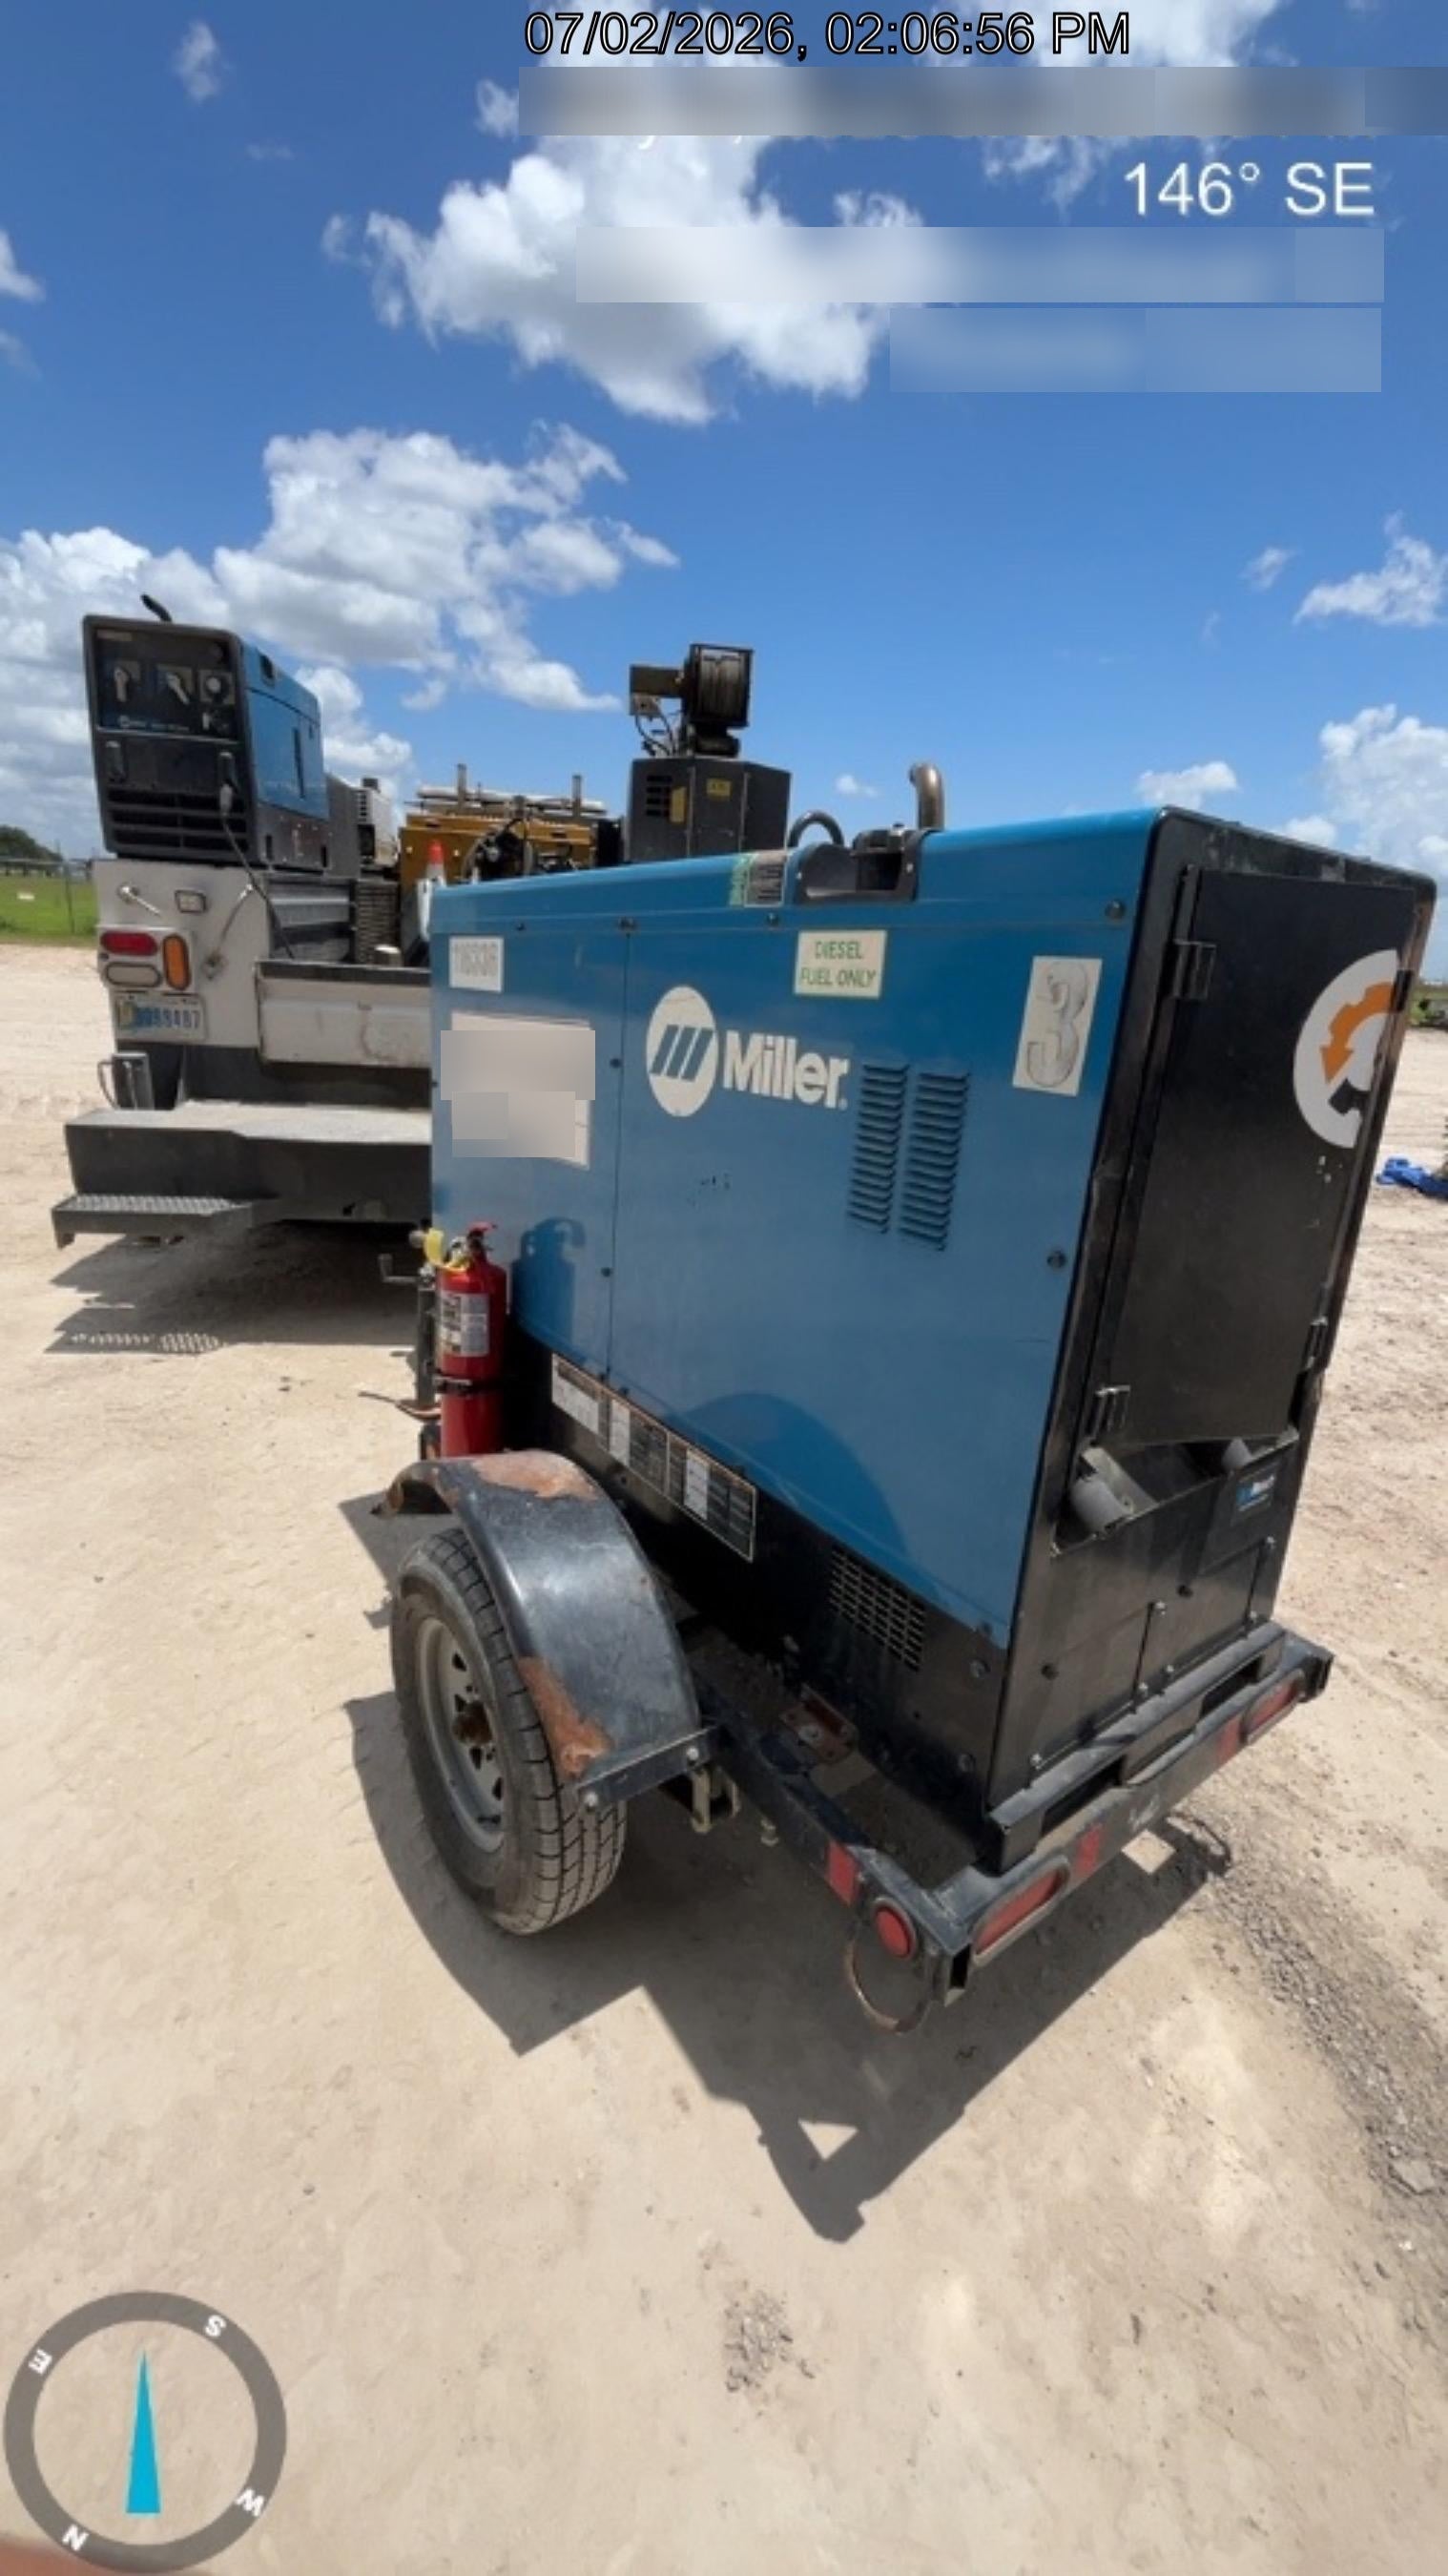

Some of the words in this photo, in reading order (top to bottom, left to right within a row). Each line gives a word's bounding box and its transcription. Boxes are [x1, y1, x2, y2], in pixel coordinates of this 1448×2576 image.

[816, 941, 864, 960] DIESEL
[801, 967, 833, 986] FUEL
[838, 968, 877, 989] ONLY
[1027, 961, 1089, 1087] 3
[722, 1028, 850, 1109] Miller
